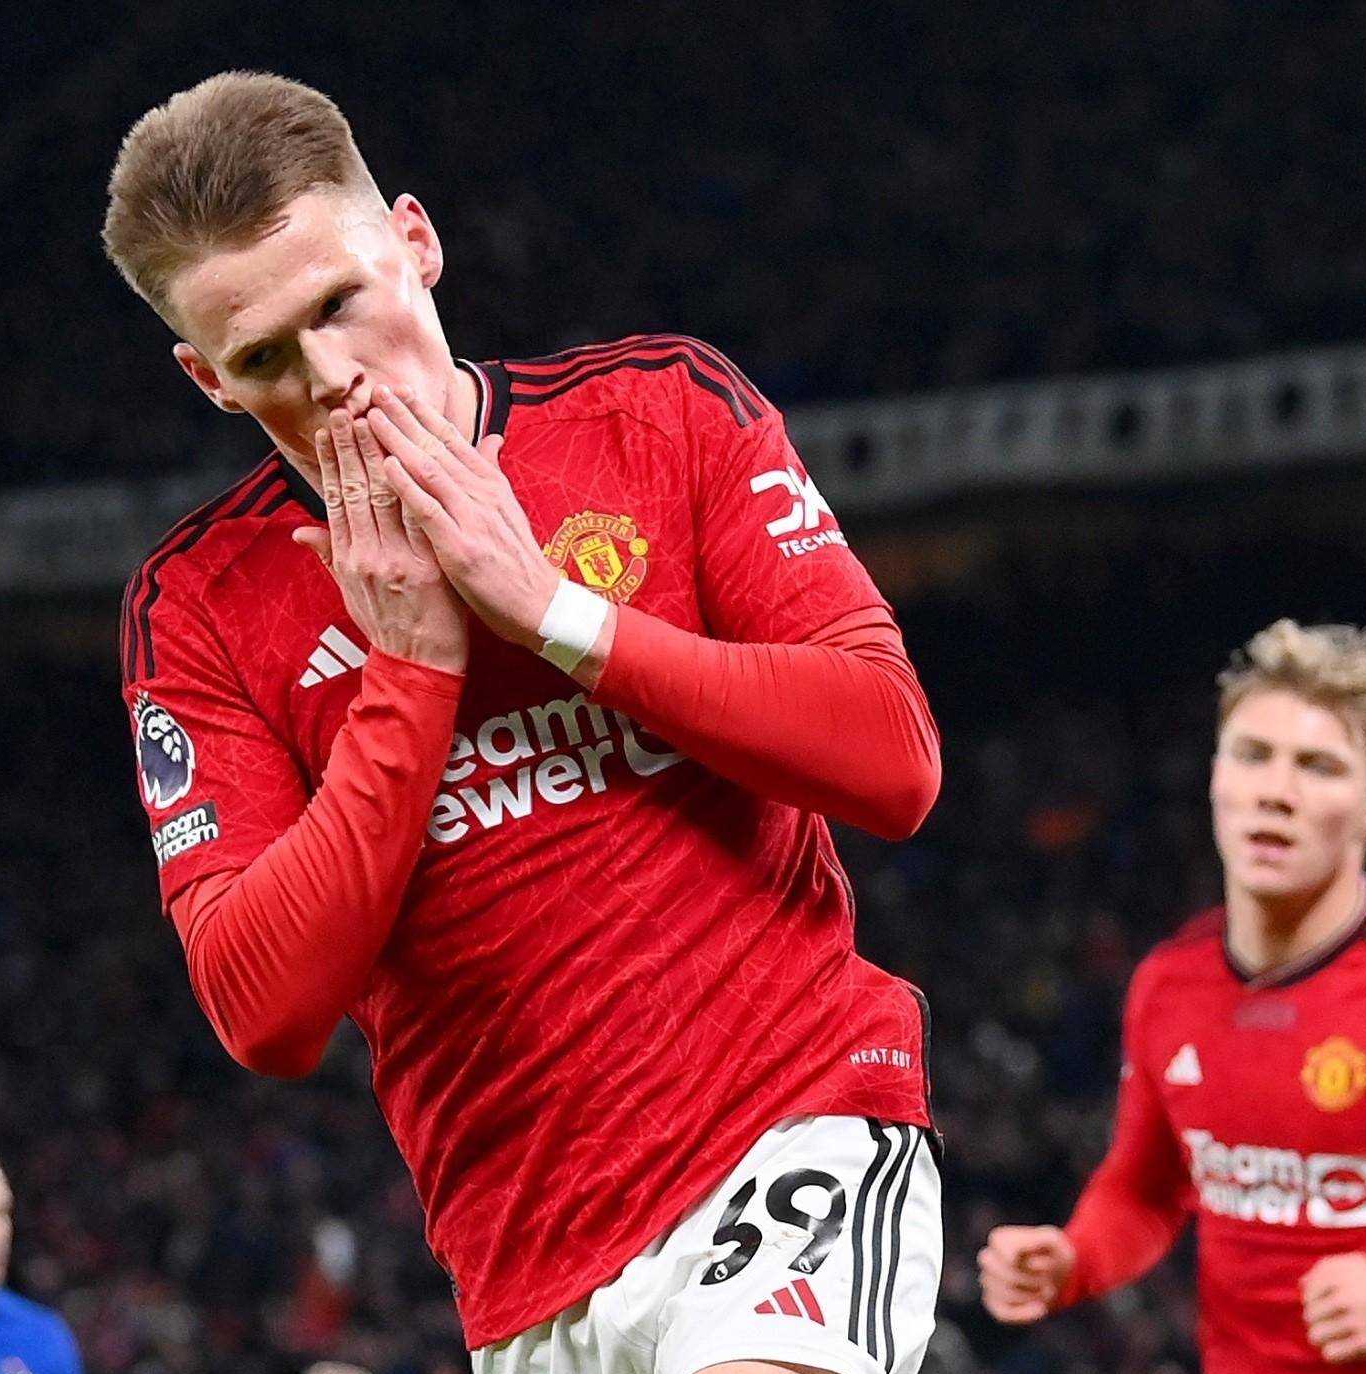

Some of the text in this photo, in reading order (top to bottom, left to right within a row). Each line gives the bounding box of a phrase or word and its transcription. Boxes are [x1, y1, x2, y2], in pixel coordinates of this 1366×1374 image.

[550, 517, 630, 561] MANCHESTER
[440, 692, 610, 782] eam
[426, 740, 614, 843] ewer
[161, 807, 207, 843] room
[162, 822, 219, 862] racism
